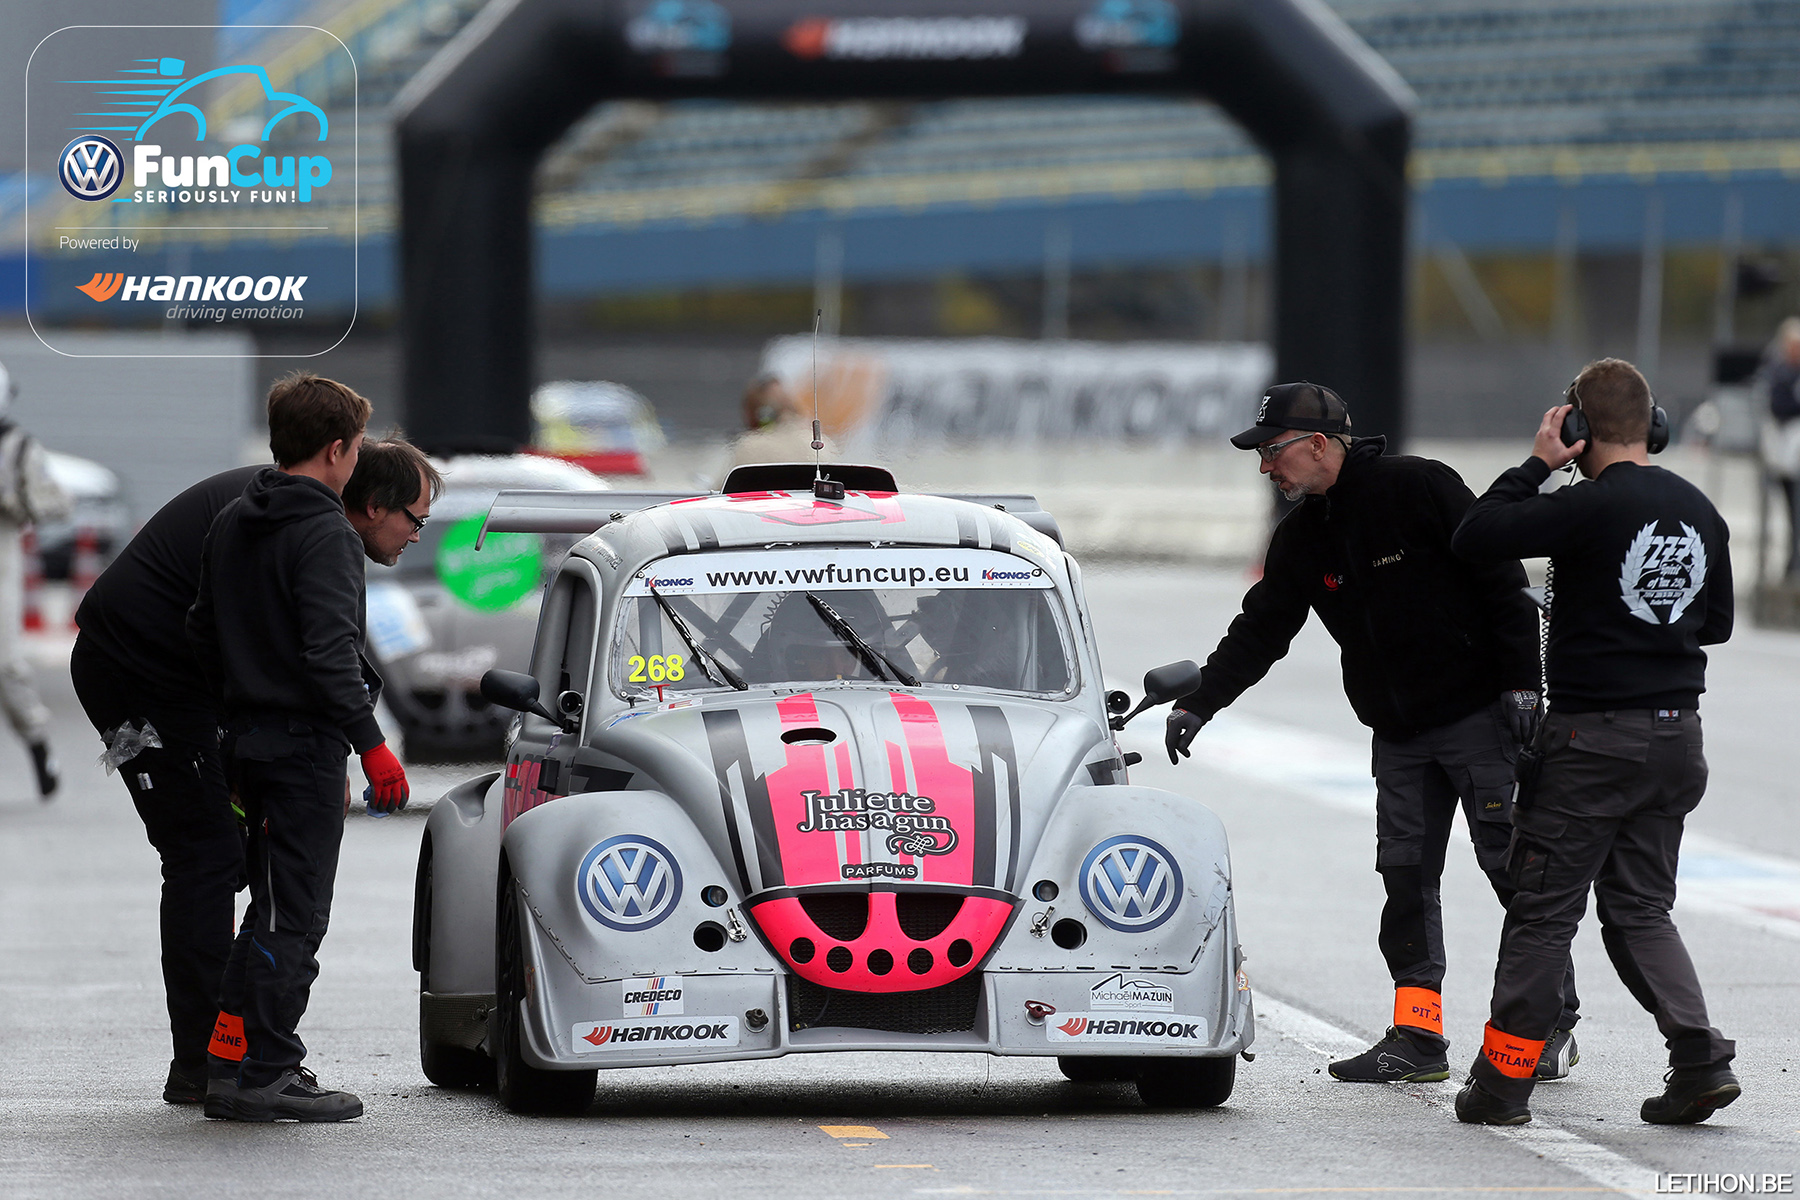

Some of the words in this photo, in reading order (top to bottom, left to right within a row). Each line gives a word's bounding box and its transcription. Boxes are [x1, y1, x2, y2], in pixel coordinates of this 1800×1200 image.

[645, 575, 694, 588] KRONOS
[706, 562, 969, 588] www.vwfuncup.eu
[982, 567, 1031, 580] KRONOS
[628, 653, 685, 683] 268
[799, 789, 932, 832] Juliette
[819, 812, 867, 831] has
[874, 814, 890, 828] a
[896, 815, 950, 833] gun
[845, 865, 916, 877] PARFUMS
[624, 989, 682, 1004] CREDECO
[610, 1023, 729, 1043] HANKOOK
[1086, 1019, 1199, 1039] HANKOOK
[1488, 1048, 1535, 1068] PITLANE
